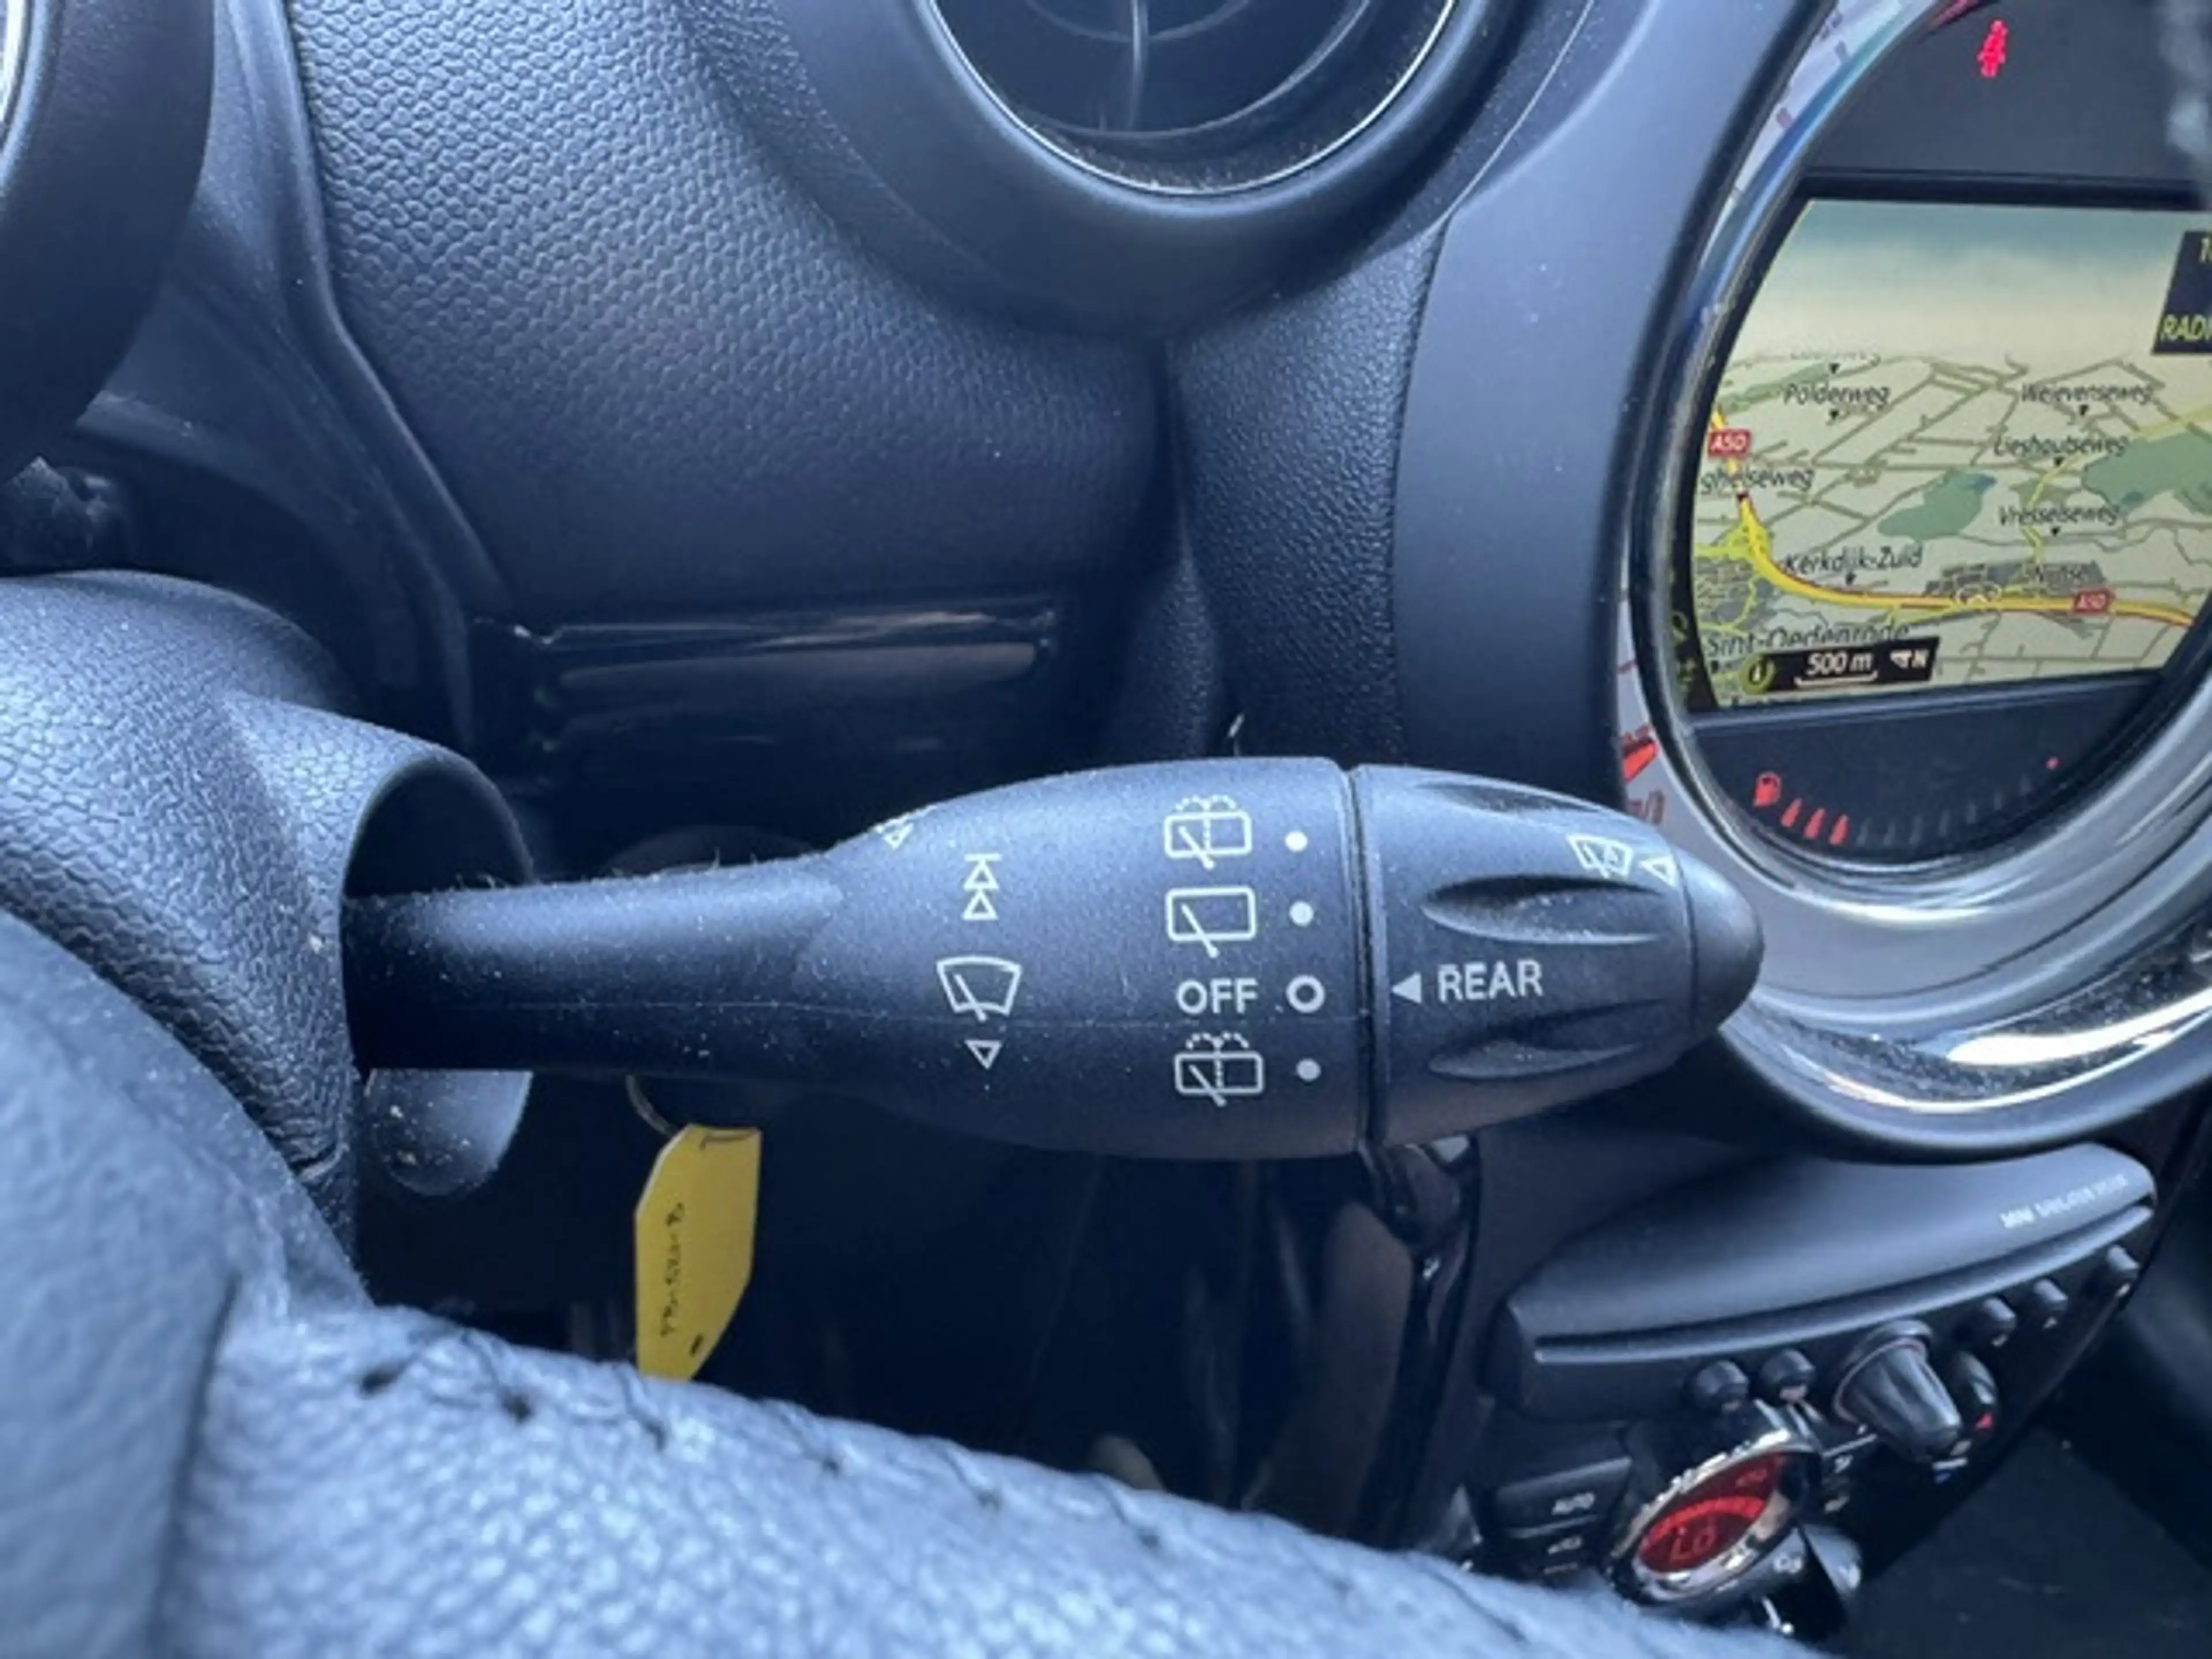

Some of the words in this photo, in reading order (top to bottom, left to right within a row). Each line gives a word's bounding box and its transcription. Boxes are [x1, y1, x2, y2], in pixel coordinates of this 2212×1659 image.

[1783, 381, 1891, 406] Polderweg
[1710, 434, 1748, 453] A50
[1806, 652, 1847, 677] 500
[1849, 652, 1873, 672] m
[1438, 959, 1544, 1003] REAR
[1176, 978, 1258, 1014] OFF
